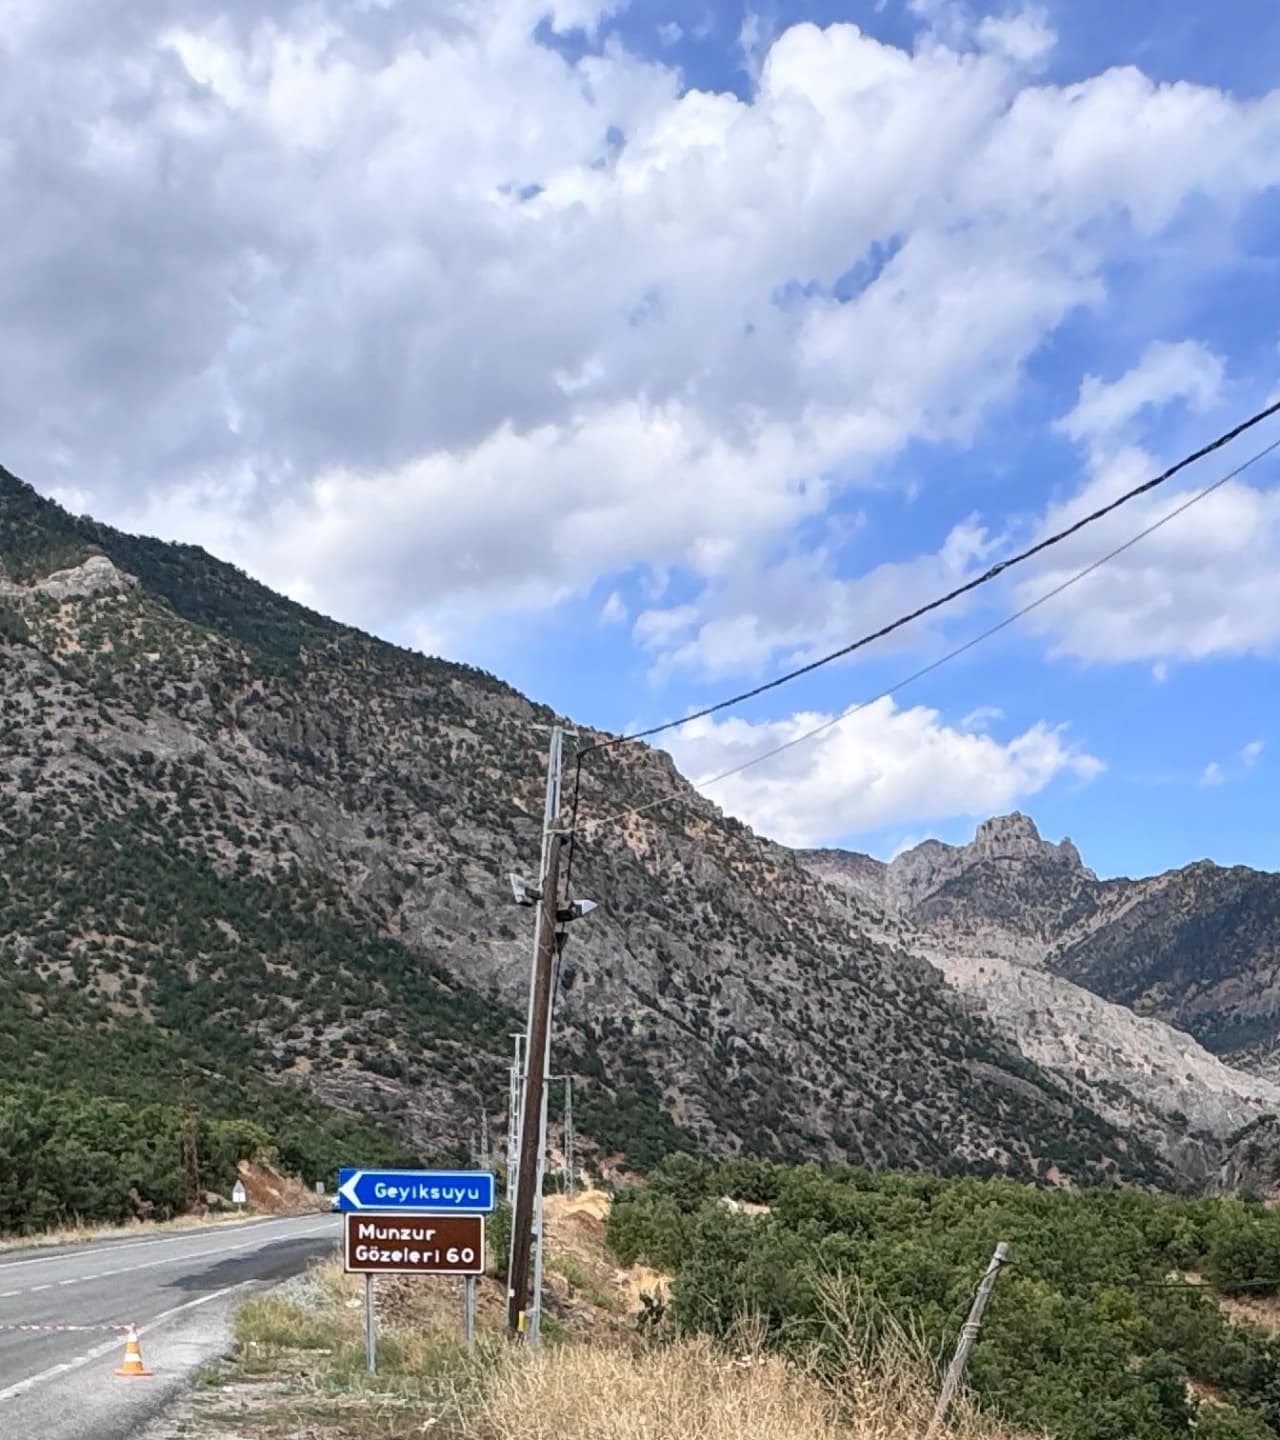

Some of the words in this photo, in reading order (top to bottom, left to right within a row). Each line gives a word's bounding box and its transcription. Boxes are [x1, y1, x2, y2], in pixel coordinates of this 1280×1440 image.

[358, 1223, 437, 1241] Munzur
[355, 1245, 440, 1264] Gözeleri
[446, 1247, 474, 1263] 60
